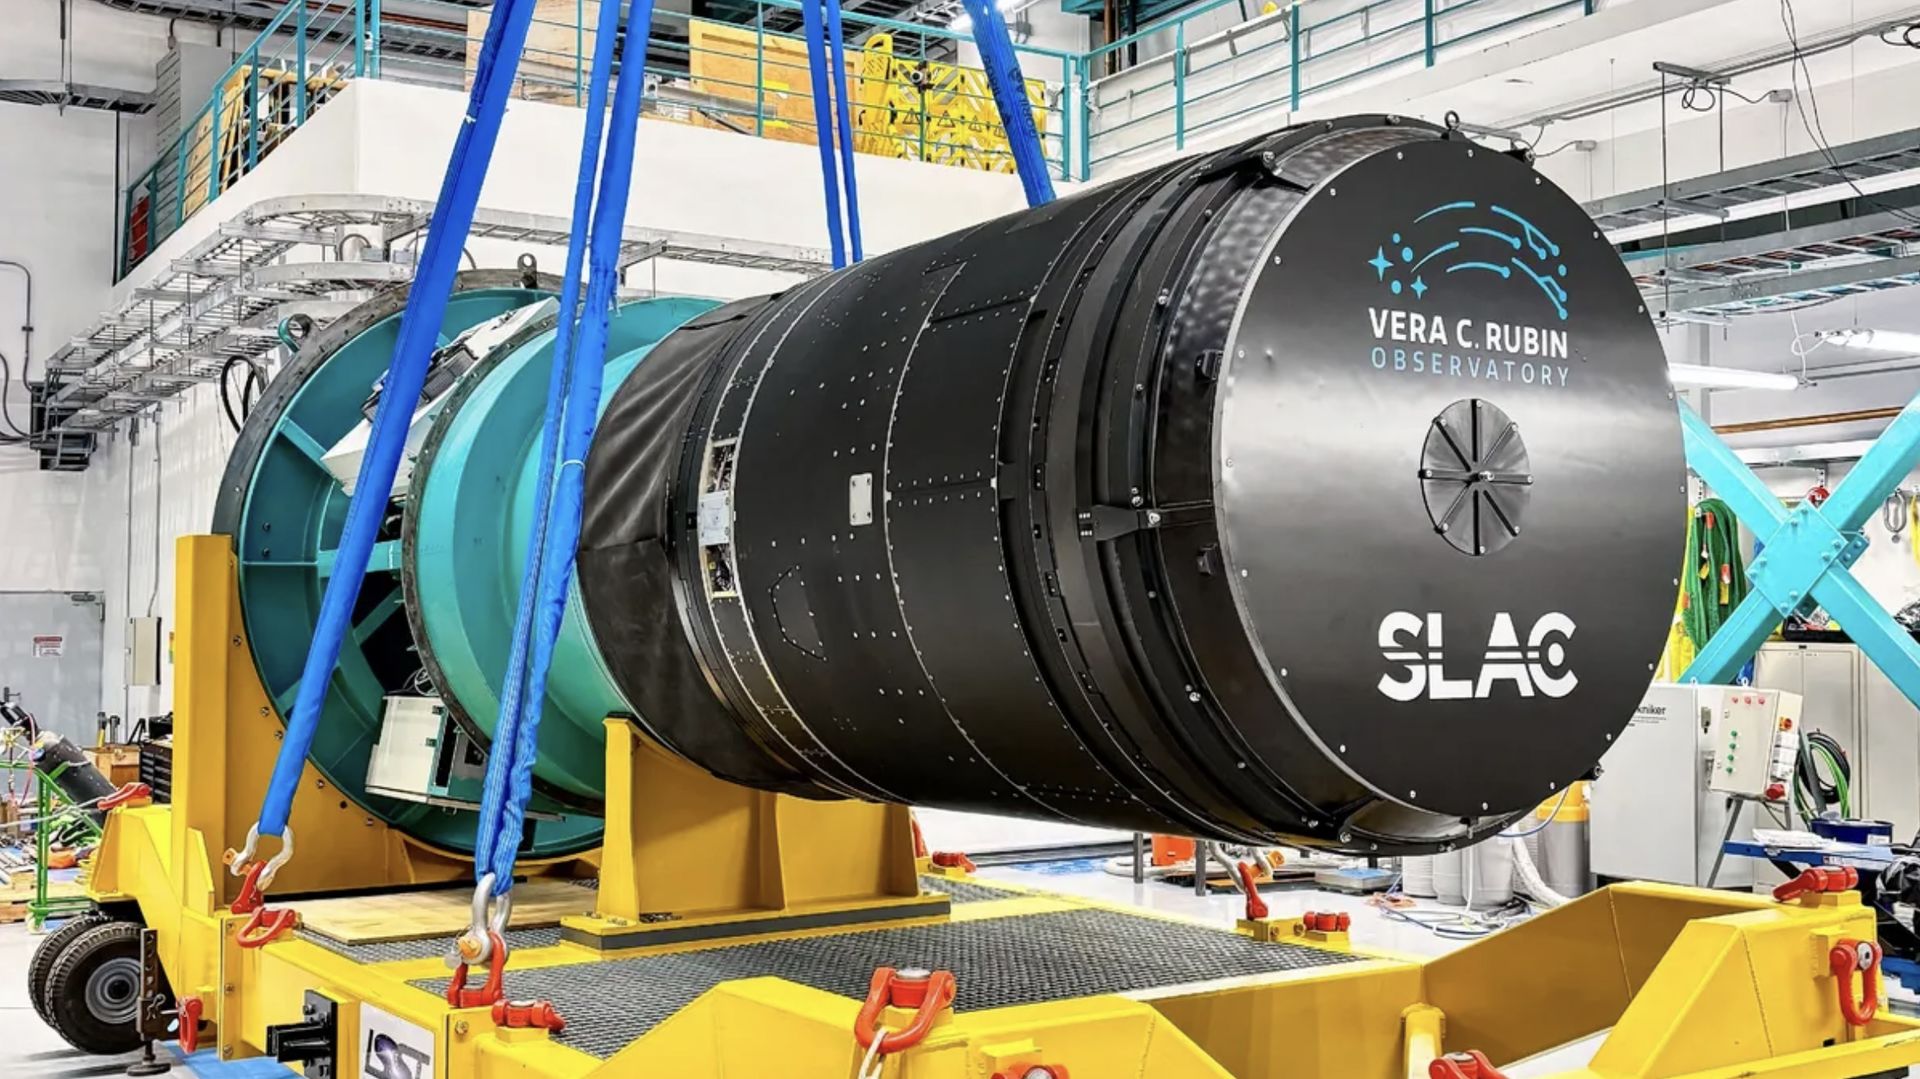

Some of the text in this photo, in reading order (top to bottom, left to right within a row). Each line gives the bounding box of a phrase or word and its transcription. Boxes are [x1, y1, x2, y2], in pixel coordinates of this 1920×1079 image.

[1368, 308, 1568, 359] VERA C. RUBIN
[1371, 347, 1569, 387] OBSERVATORY
[1377, 611, 1579, 701] SLAC
